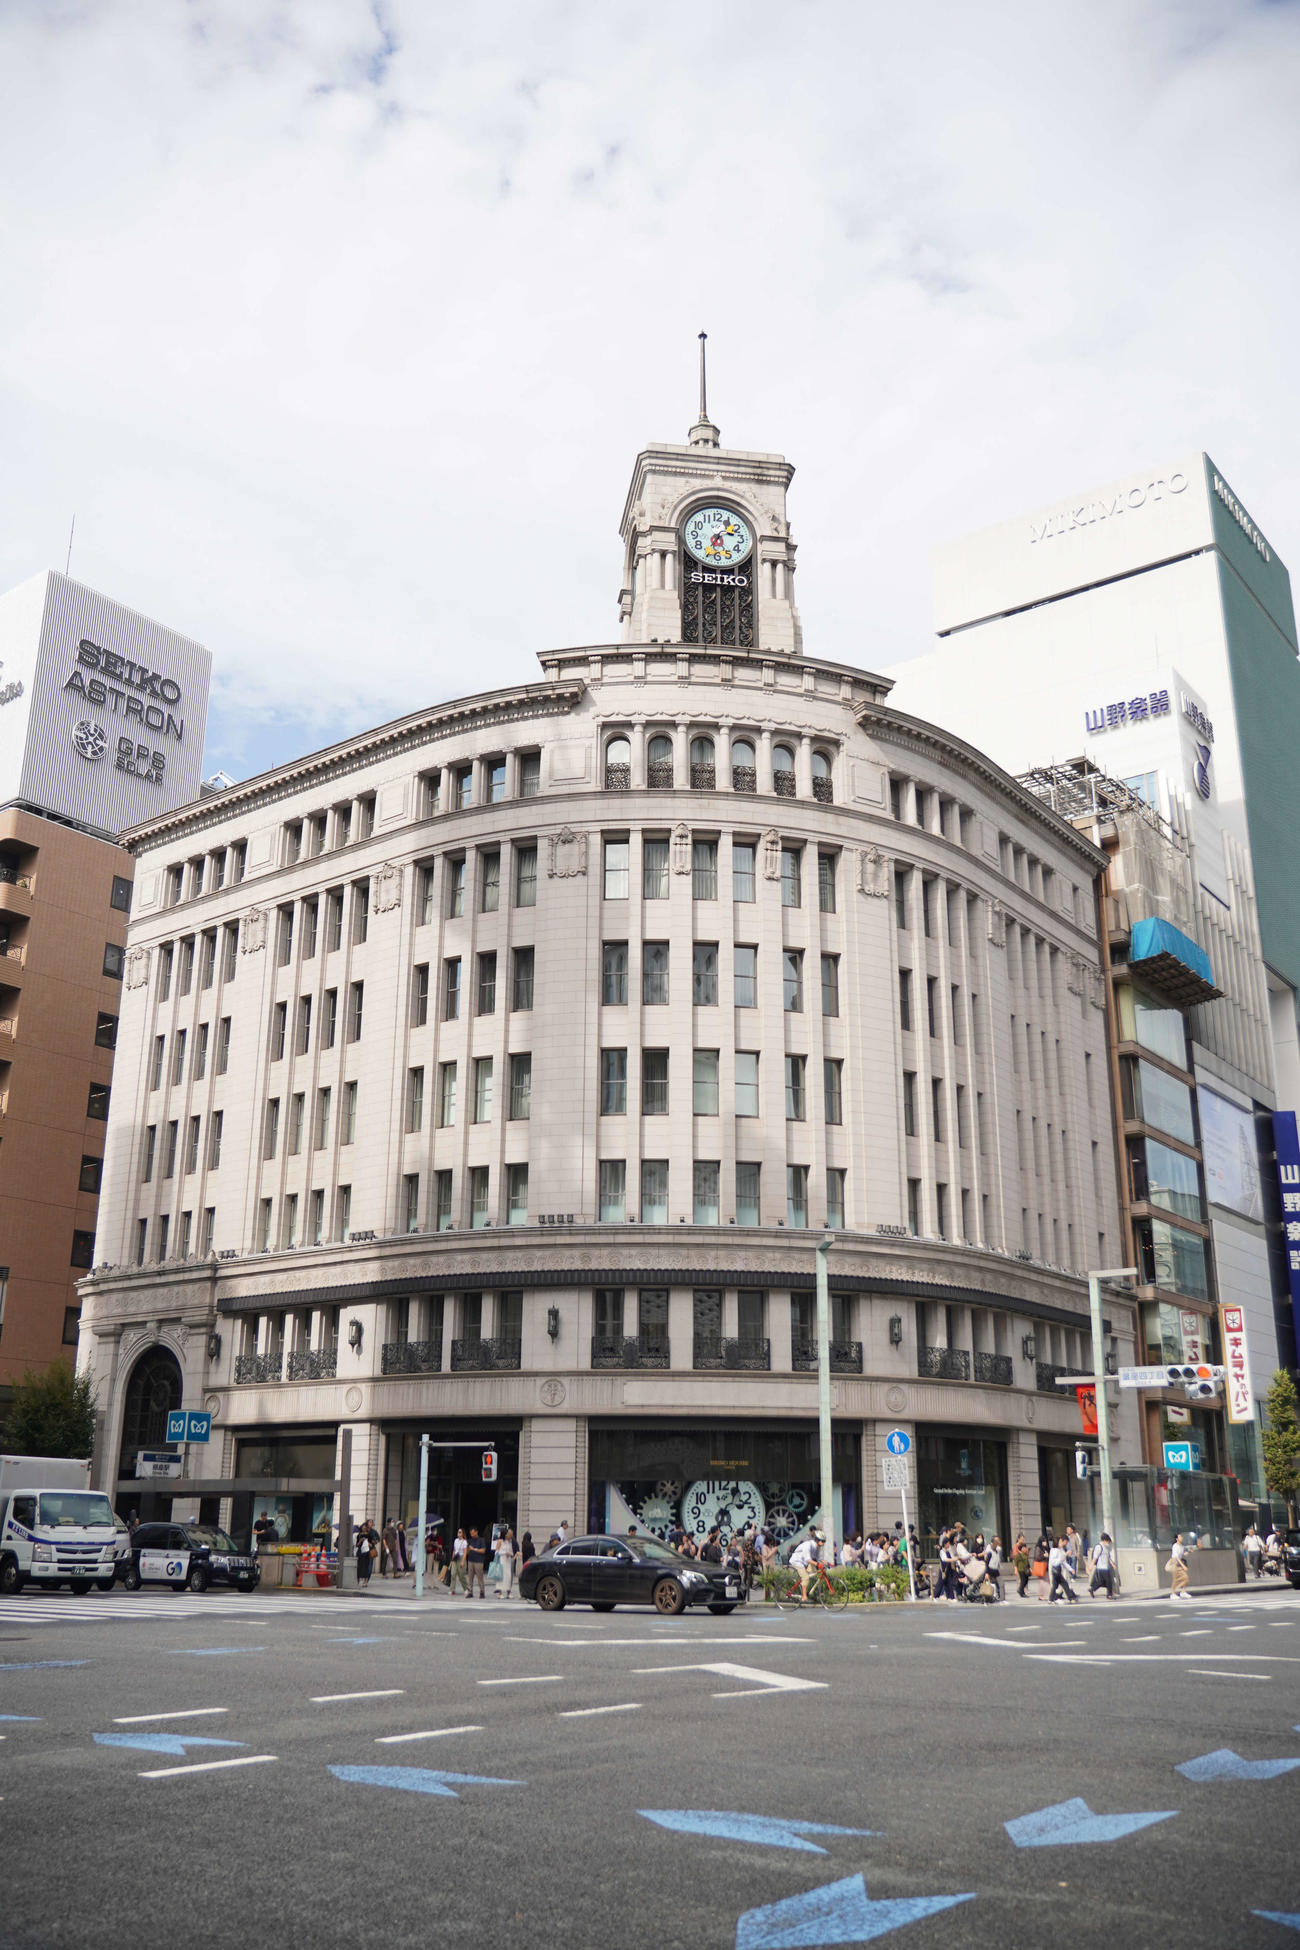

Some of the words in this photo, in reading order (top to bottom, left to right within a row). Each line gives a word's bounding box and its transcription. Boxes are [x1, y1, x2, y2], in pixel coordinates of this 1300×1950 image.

[1030, 473, 1189, 544] MIKIMOTO
[704, 514, 711, 523] 11
[713, 513, 722, 522] 12
[695, 521, 703, 530] 10
[691, 530, 698, 539] 9
[738, 535, 744, 543] 3
[695, 540, 702, 549] 8
[733, 544, 741, 553] 4
[714, 552, 721, 561] 6
[691, 572, 747, 586] SEIKO
[76, 639, 181, 704] SEIKO
[63, 670, 184, 741] ASTRON
[1085, 690, 1170, 732] 山野楽器
[117, 737, 166, 770] GPS
[114, 756, 163, 785] SOLAR
[1230, 1337, 1249, 1414] キムラヤのパン
[707, 1481, 715, 1494] 11
[695, 1492, 706, 1505] 10
[743, 1491, 752, 1504] 2
[691, 1506, 700, 1519] 9
[747, 1506, 756, 1519] 3
[696, 1520, 705, 1533] 8
[720, 1534, 728, 1547] 6
